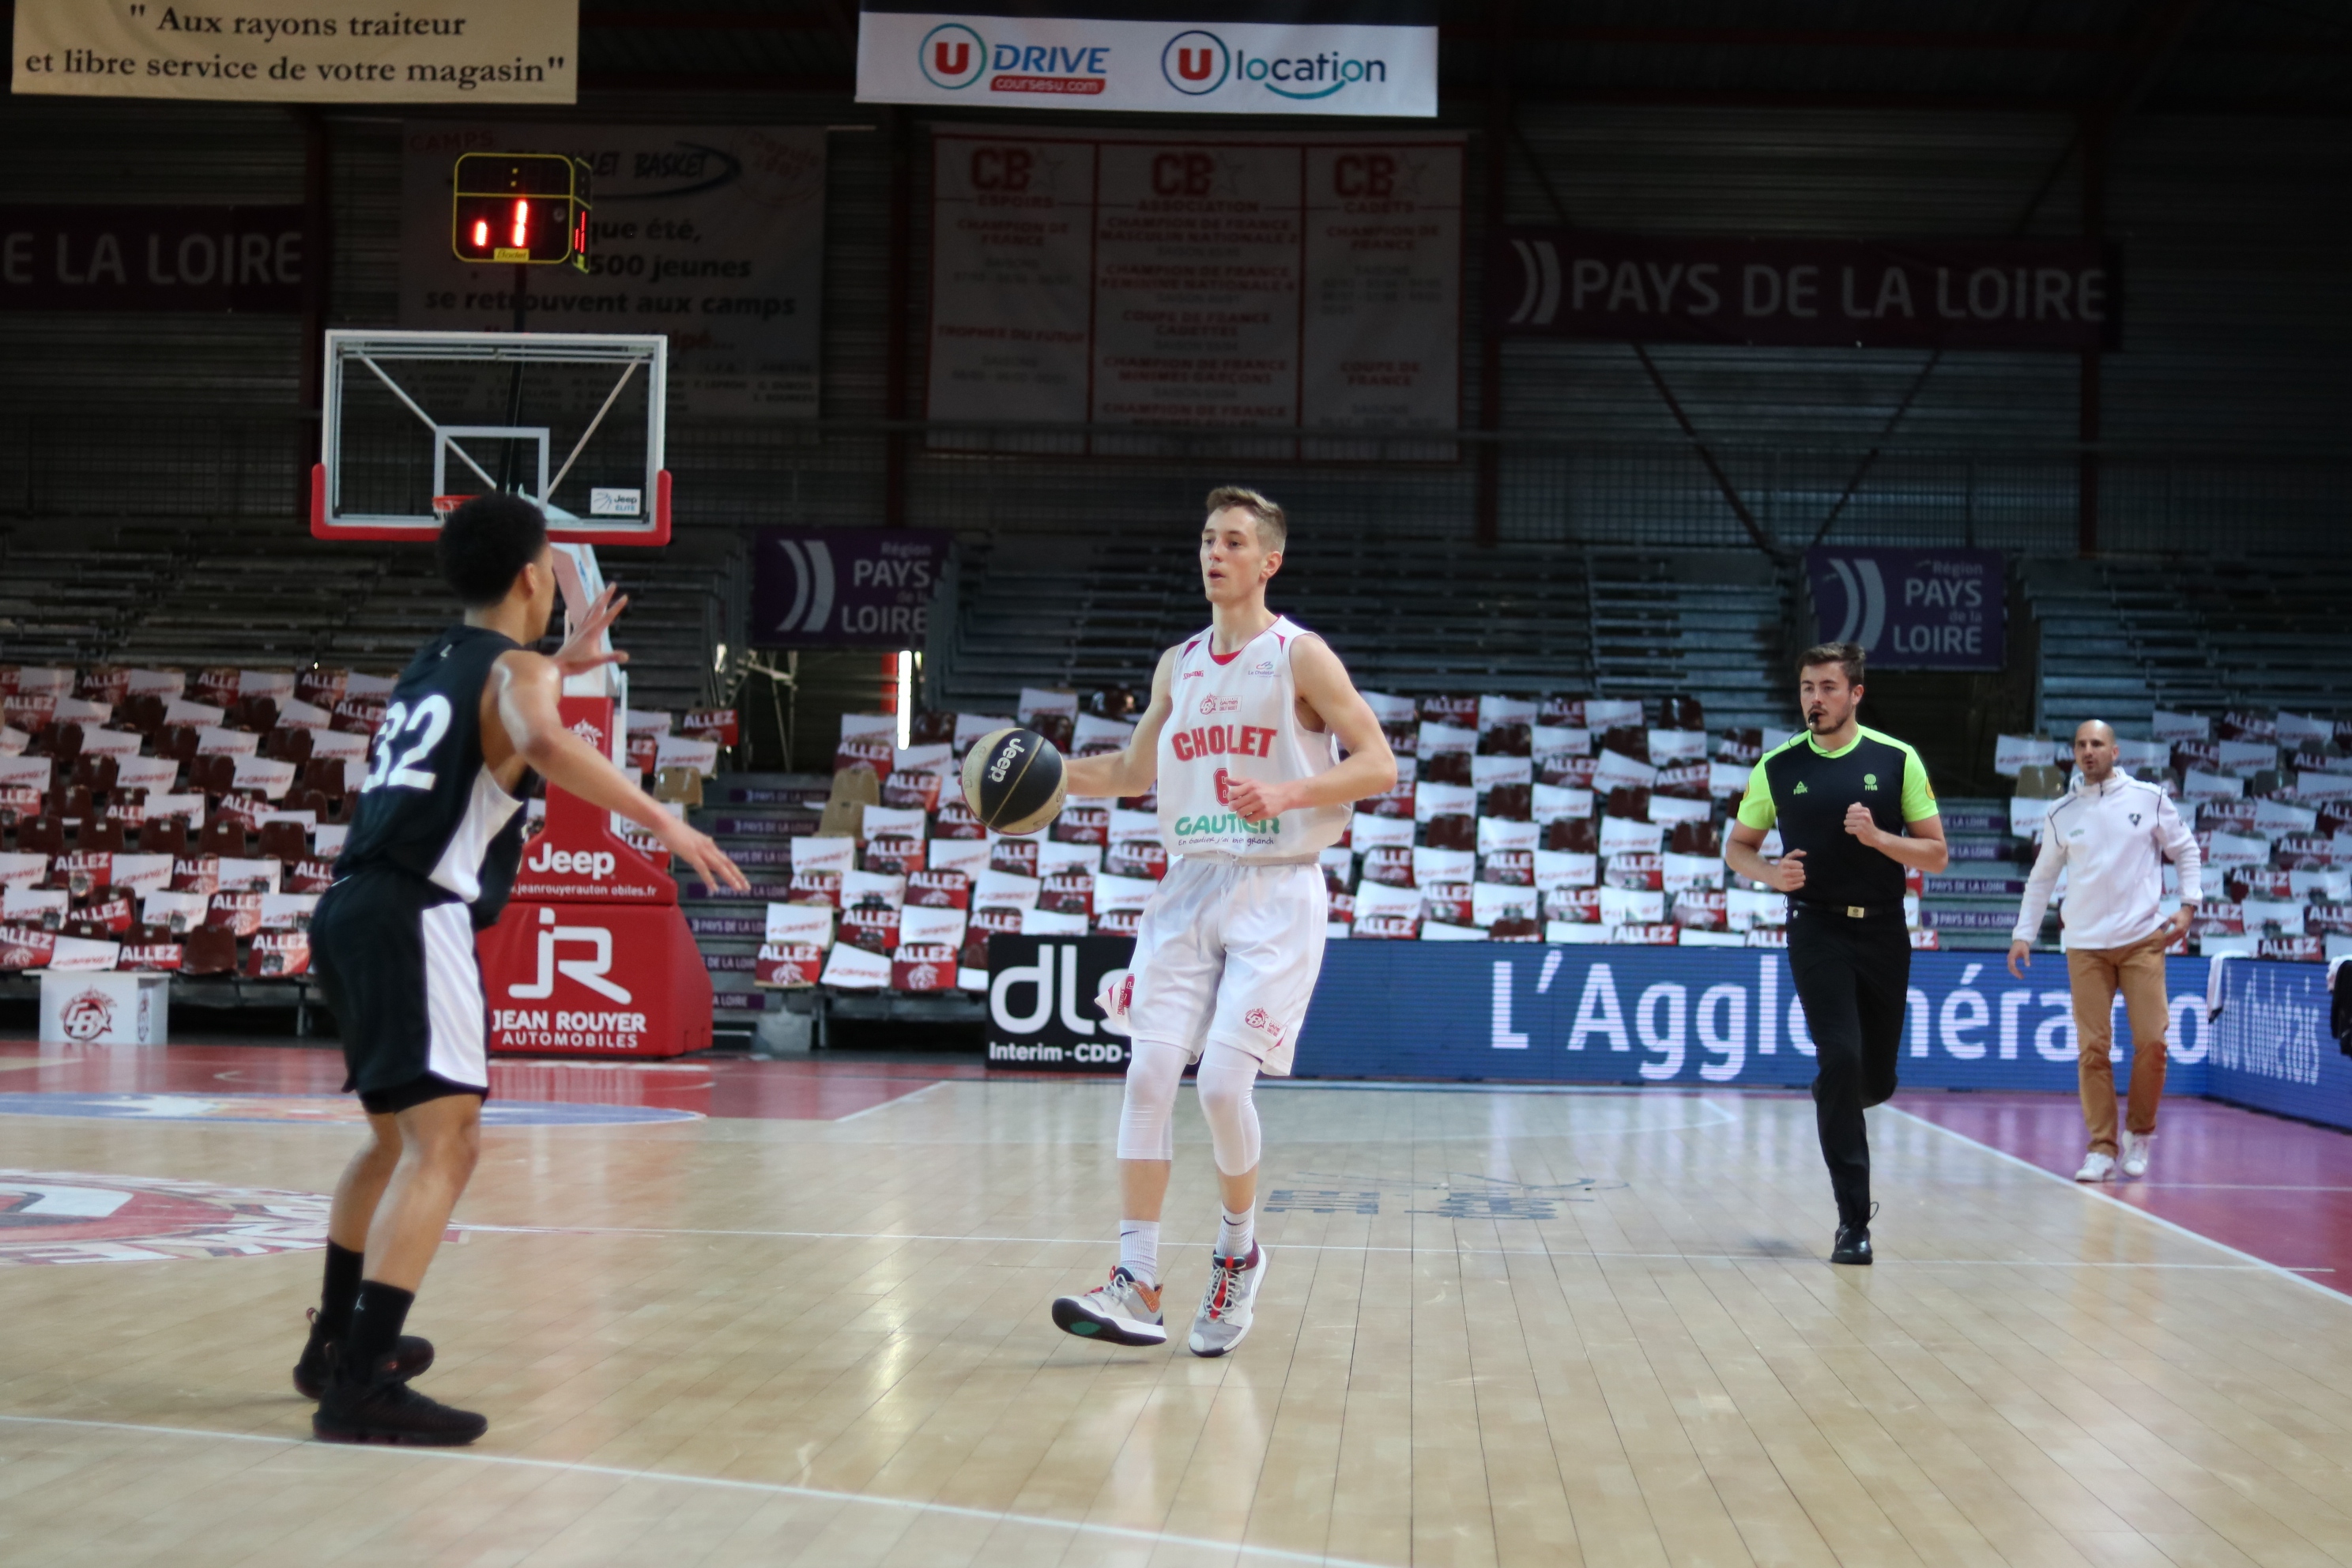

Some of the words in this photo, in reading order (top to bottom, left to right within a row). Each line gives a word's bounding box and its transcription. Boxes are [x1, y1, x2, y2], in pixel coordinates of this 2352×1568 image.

[157, 9, 222, 34] Aux
[232, 15, 337, 42] rayons
[349, 10, 466, 36] traiteur
[25, 53, 54, 74] et
[65, 50, 135, 75] libre
[147, 56, 256, 80] service
[269, 55, 307, 81] de
[317, 60, 396, 81] votre
[935, 42, 969, 74] U
[993, 43, 1110, 74] DRIVE
[1178, 48, 1212, 81] U
[1237, 49, 1386, 82] location
[996, 77, 1099, 92] coursesu.com
[409, 130, 495, 151] CAMPS
[635, 153, 707, 179] BASKET
[971, 146, 1032, 192] CB
[1152, 152, 1215, 197] CB
[1334, 153, 1395, 198] CB
[56, 234, 126, 285] LA
[147, 234, 303, 285] LOIRE
[651, 257, 751, 282] jeunes
[1571, 259, 1721, 316] PAYS
[1743, 263, 1819, 317] DE
[1841, 265, 1917, 318] LA
[1936, 266, 2109, 323] LOIRE
[425, 291, 456, 310] se
[637, 295, 692, 315] aux
[701, 293, 797, 319] camps
[613, 495, 637, 505] Jeep
[853, 559, 931, 588] PAYS
[1904, 578, 1983, 608] PAYS
[842, 605, 928, 634] LOIRE
[1893, 624, 1983, 655] LOIRE
[4, 695, 55, 711] ALLEZ
[1423, 699, 1475, 712] ALLEZ
[684, 710, 736, 729] ALLEZ
[837, 741, 891, 761] ALLEZ
[1171, 725, 1278, 761] CHOLET
[990, 737, 1026, 782] Jeep
[1545, 757, 1598, 774] ALLEZ
[886, 772, 940, 791] ALLEZ
[867, 840, 923, 857] ALLEZ
[1109, 844, 1165, 863] ALLEZ
[55, 851, 109, 871] ALLEZ
[528, 842, 616, 880] Jeep
[1608, 854, 1663, 871] ALLEZ
[908, 872, 967, 889] ALLEZ
[2233, 869, 2288, 887] ALLEZ
[842, 910, 900, 928] ALLEZ
[1354, 918, 1414, 936] ALLEZ
[252, 933, 309, 950] ALLEZ
[1614, 925, 1674, 943] ALLEZ
[119, 944, 179, 962] ALLEZ
[758, 944, 819, 961] ALLEZ
[893, 945, 954, 963] ALLEZ
[2262, 937, 2317, 956] ALLEZ
[493, 1009, 548, 1031] JEAN
[556, 1012, 647, 1034] ROUYER
[2244, 967, 2320, 1086] Choletais
[502, 1031, 638, 1049] AUTOMOBILES
